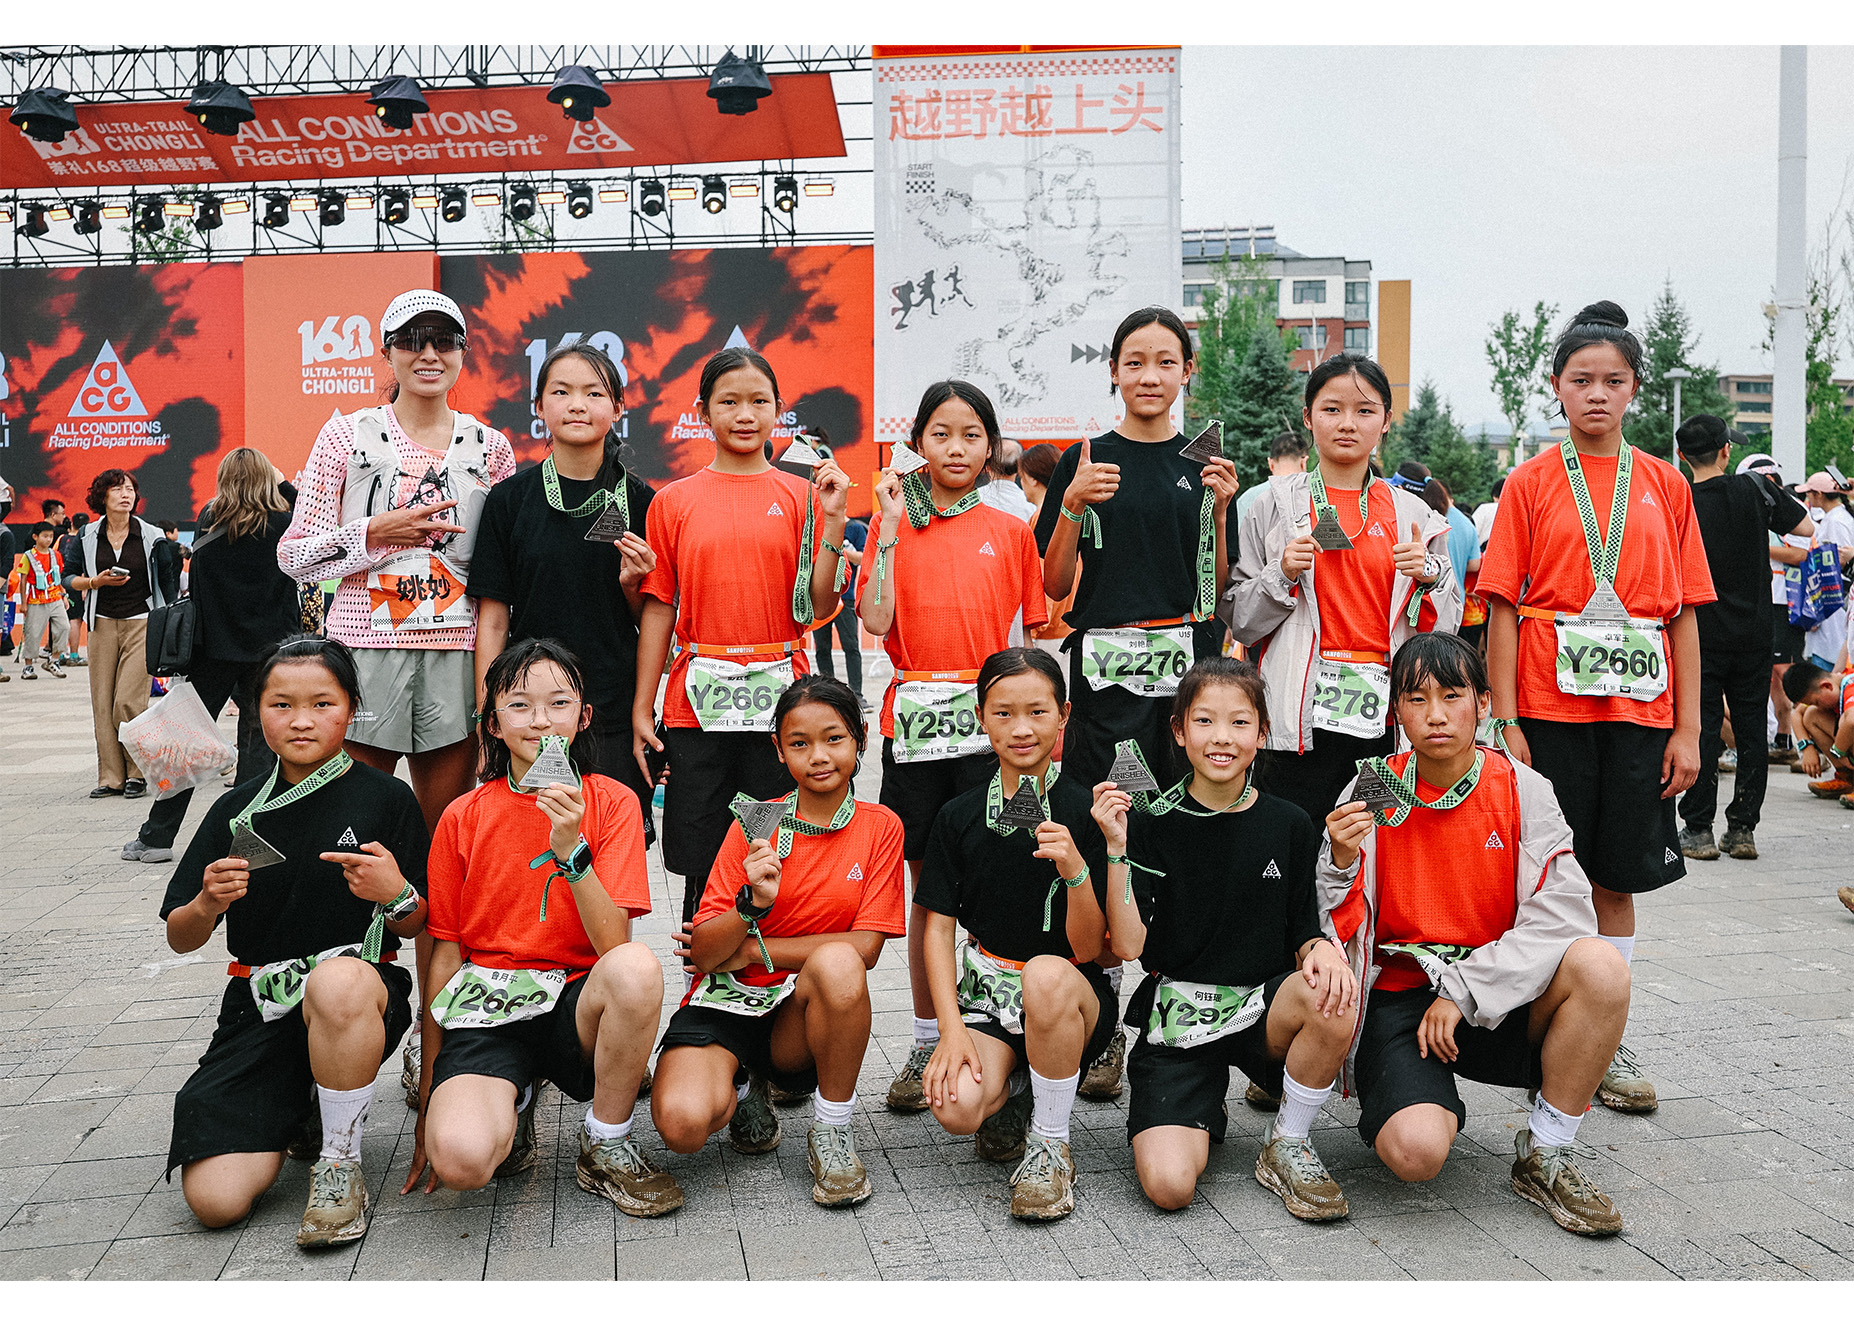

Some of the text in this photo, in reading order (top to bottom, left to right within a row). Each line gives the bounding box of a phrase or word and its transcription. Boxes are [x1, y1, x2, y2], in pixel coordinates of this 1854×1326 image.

[888, 81, 1164, 143] 越野越上头
[94, 120, 194, 135] ULTRA-TRAIL
[237, 118, 302, 144] ALL
[104, 134, 205, 152] CHONGLI
[231, 143, 345, 169] Racing
[47, 156, 220, 176] 崇礼168超级越野赛
[907, 163, 933, 171] START
[298, 315, 375, 366] 168
[302, 366, 375, 377] ULTRA-TRAIL
[302, 378, 375, 395] CHONGLI
[54, 420, 162, 436] ALL CONDITIONS
[1001, 424, 1029, 433] Racing
[1005, 416, 1076, 425] ALL CONDITIONS
[48, 435, 92, 449] Racing
[396, 574, 451, 602] 姚妙
[1588, 601, 1622, 609] FINISHER
[1178, 630, 1191, 639] U15
[1090, 650, 1187, 678] Y2276
[1563, 645, 1661, 680] Y2660
[1373, 674, 1388, 685] U15
[897, 709, 988, 740] Y259
[531, 765, 572, 777] FINISHER
[1109, 770, 1148, 781] FINISHER
[752, 803, 773, 837] FINISHER
[546, 973, 563, 984] U13
